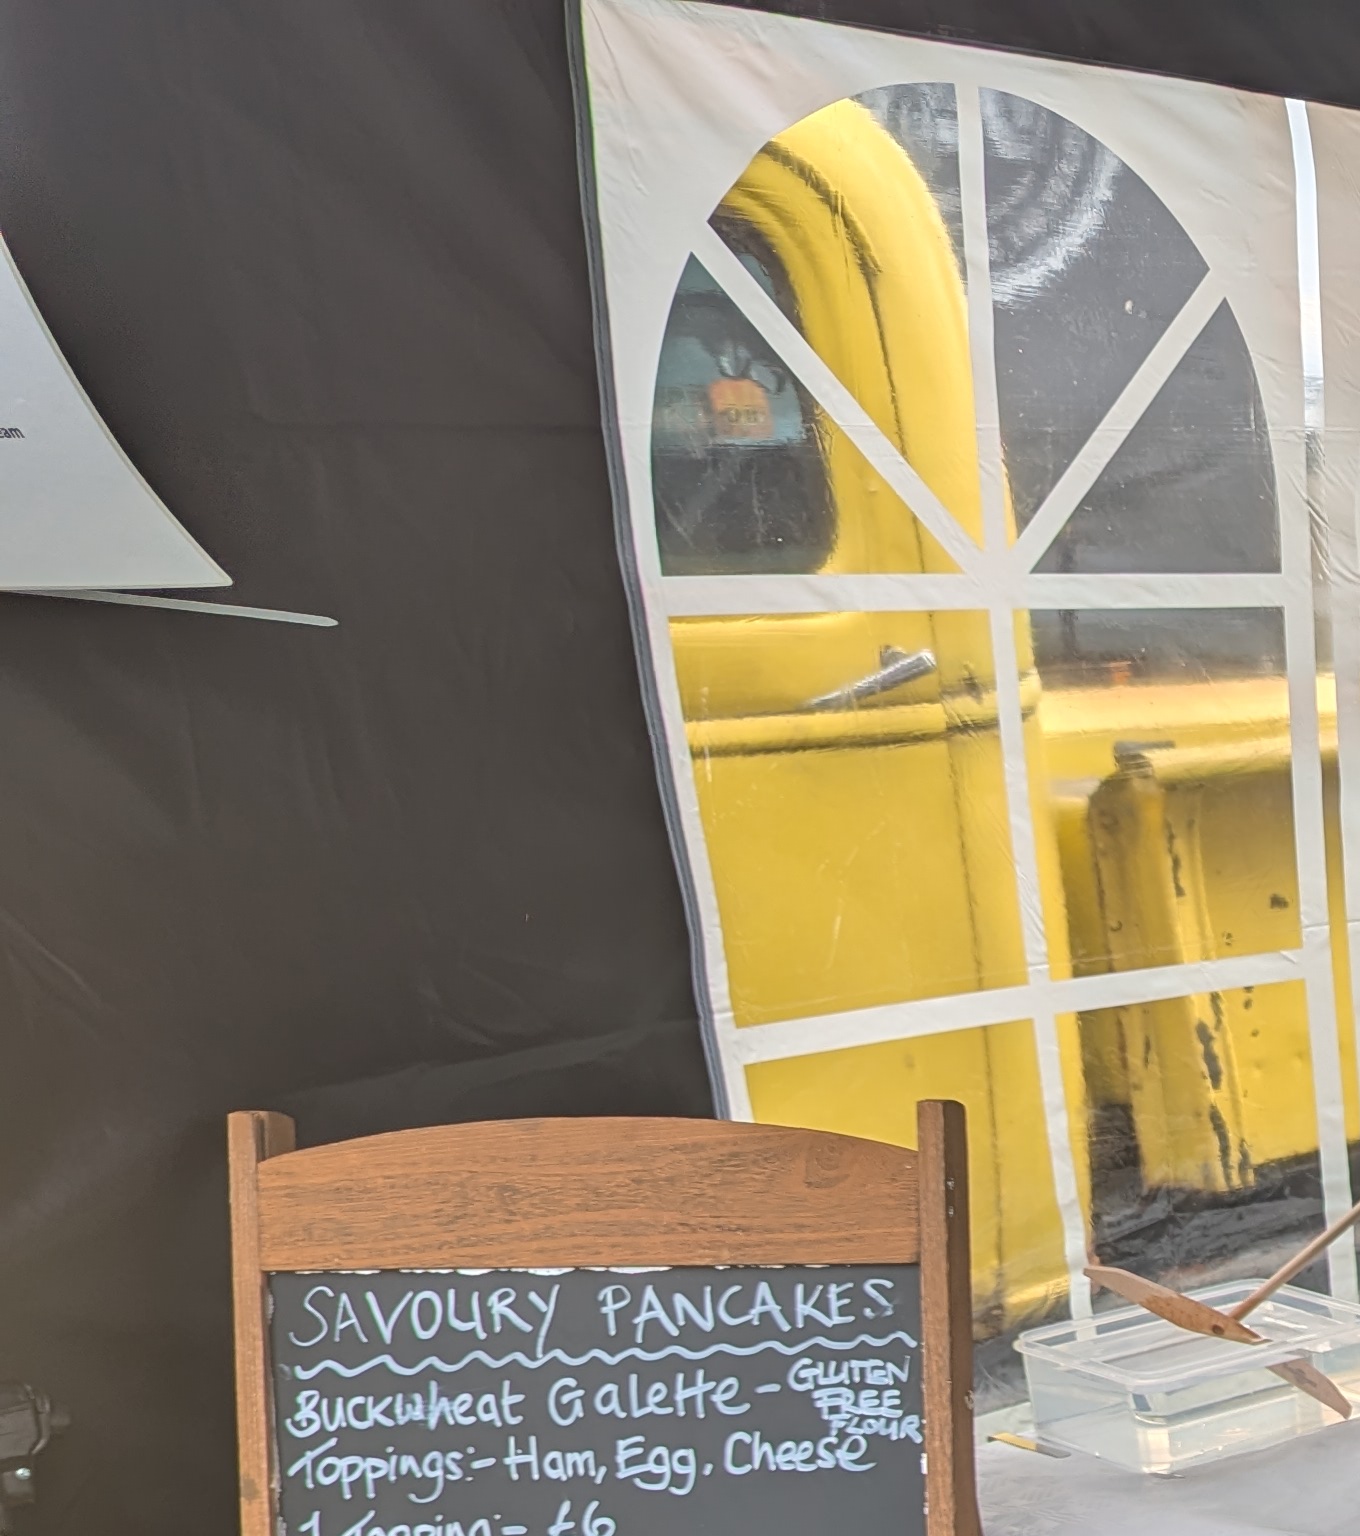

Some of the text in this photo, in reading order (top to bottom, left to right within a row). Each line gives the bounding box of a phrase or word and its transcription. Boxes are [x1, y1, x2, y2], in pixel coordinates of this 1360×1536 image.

[289, 1279, 896, 1357] SAVOURY PANCAKES
[787, 1355, 911, 1391] GLUTEN
[811, 1387, 904, 1420] FREE
[828, 1414, 923, 1444] FLOUR
[724, 1431, 878, 1472] Cheese
